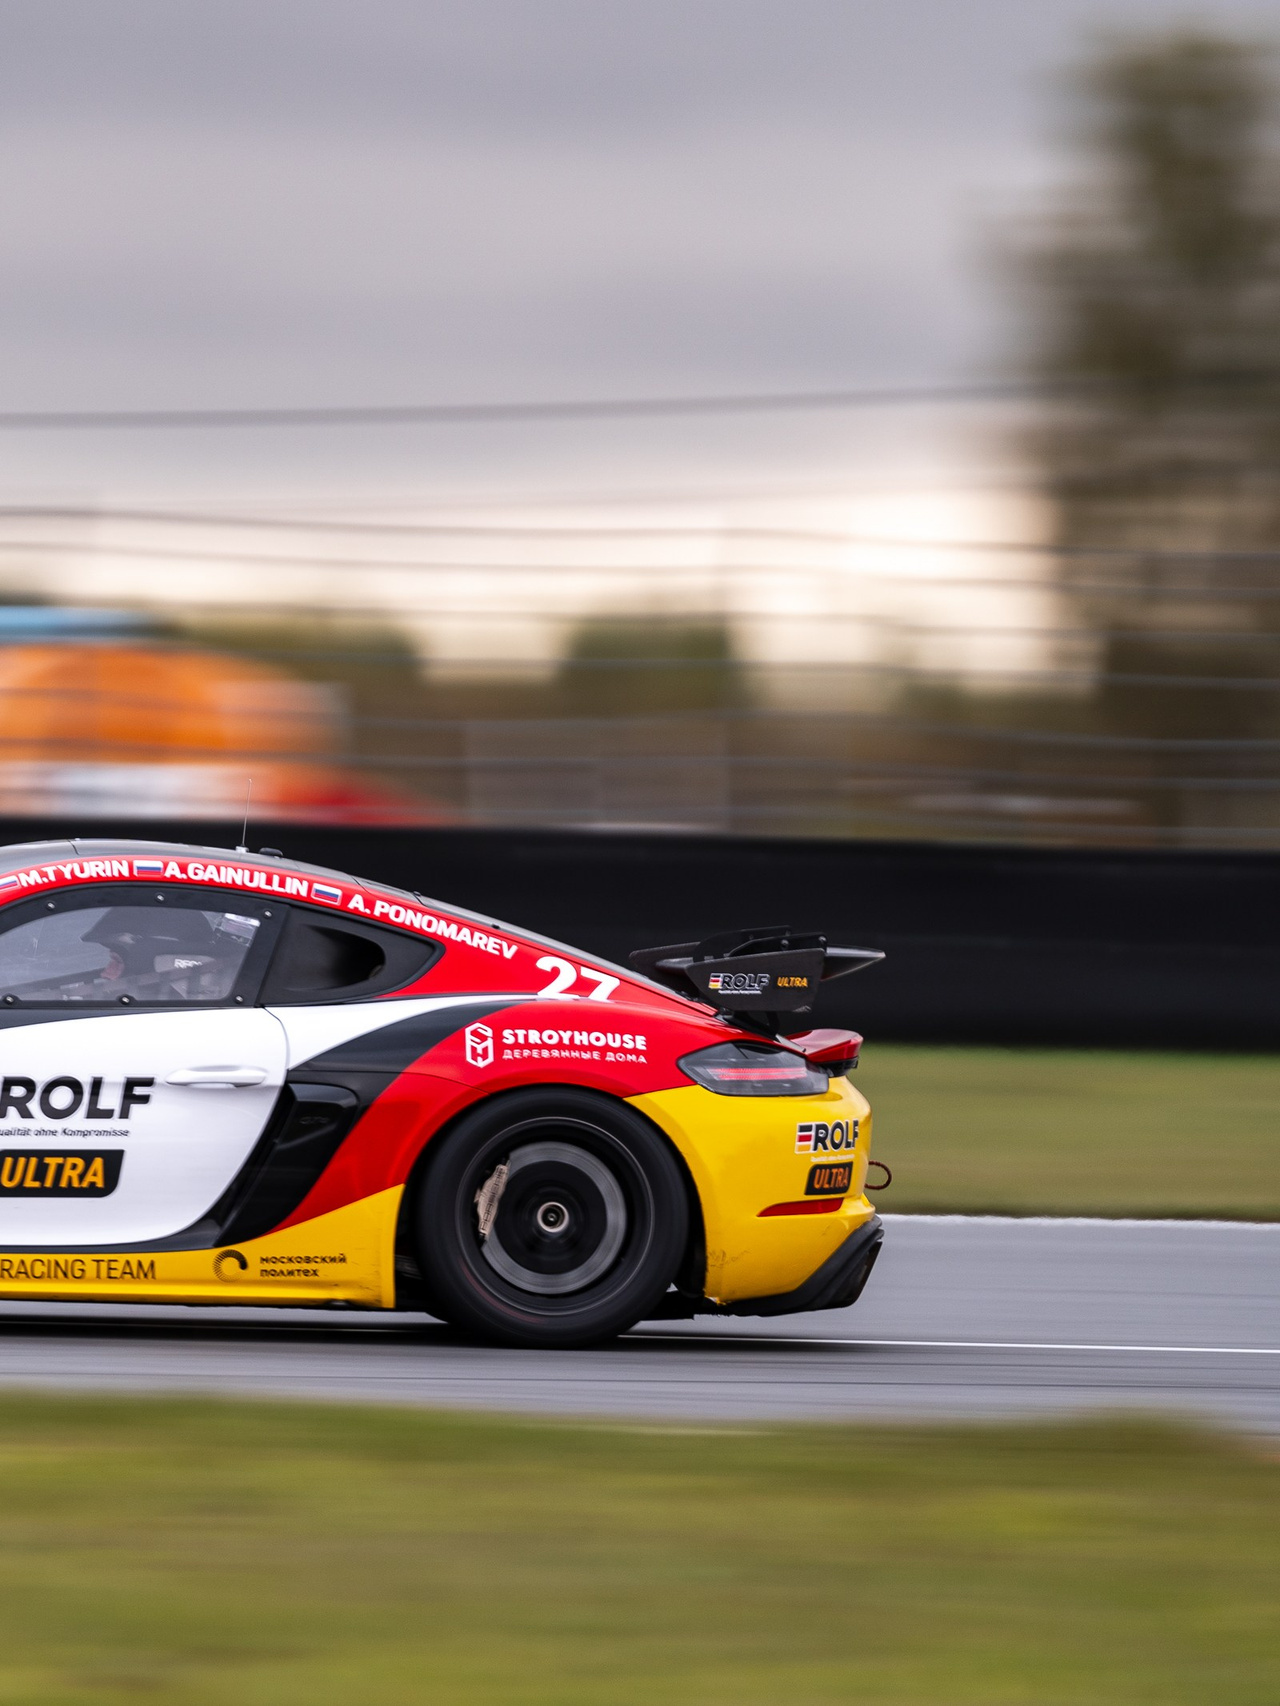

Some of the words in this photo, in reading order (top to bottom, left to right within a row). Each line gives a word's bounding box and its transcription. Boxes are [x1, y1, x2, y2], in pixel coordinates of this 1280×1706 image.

[20, 860, 130, 887] M.TYURIN
[164, 861, 309, 897] A.GAINULLIN
[347, 894, 371, 915] A.
[373, 900, 519, 959] PONOMAREV
[535, 956, 620, 1003] 27
[721, 973, 770, 990] ROLF
[777, 976, 808, 988] ULTRA
[501, 1029, 648, 1050] STROYHOUSE
[501, 1049, 602, 1061] ДЕРЕВЯННЫЕ
[605, 1052, 648, 1064] ДОМА
[33, 1127, 58, 1137] ohne
[61, 1127, 130, 1139] Kompromisse
[812, 1118, 860, 1152] ROLF
[0, 1156, 105, 1188] ULTRA
[813, 1167, 849, 1189] ULTRA
[0, 1258, 87, 1280] RACING
[91, 1259, 157, 1280] TEAM
